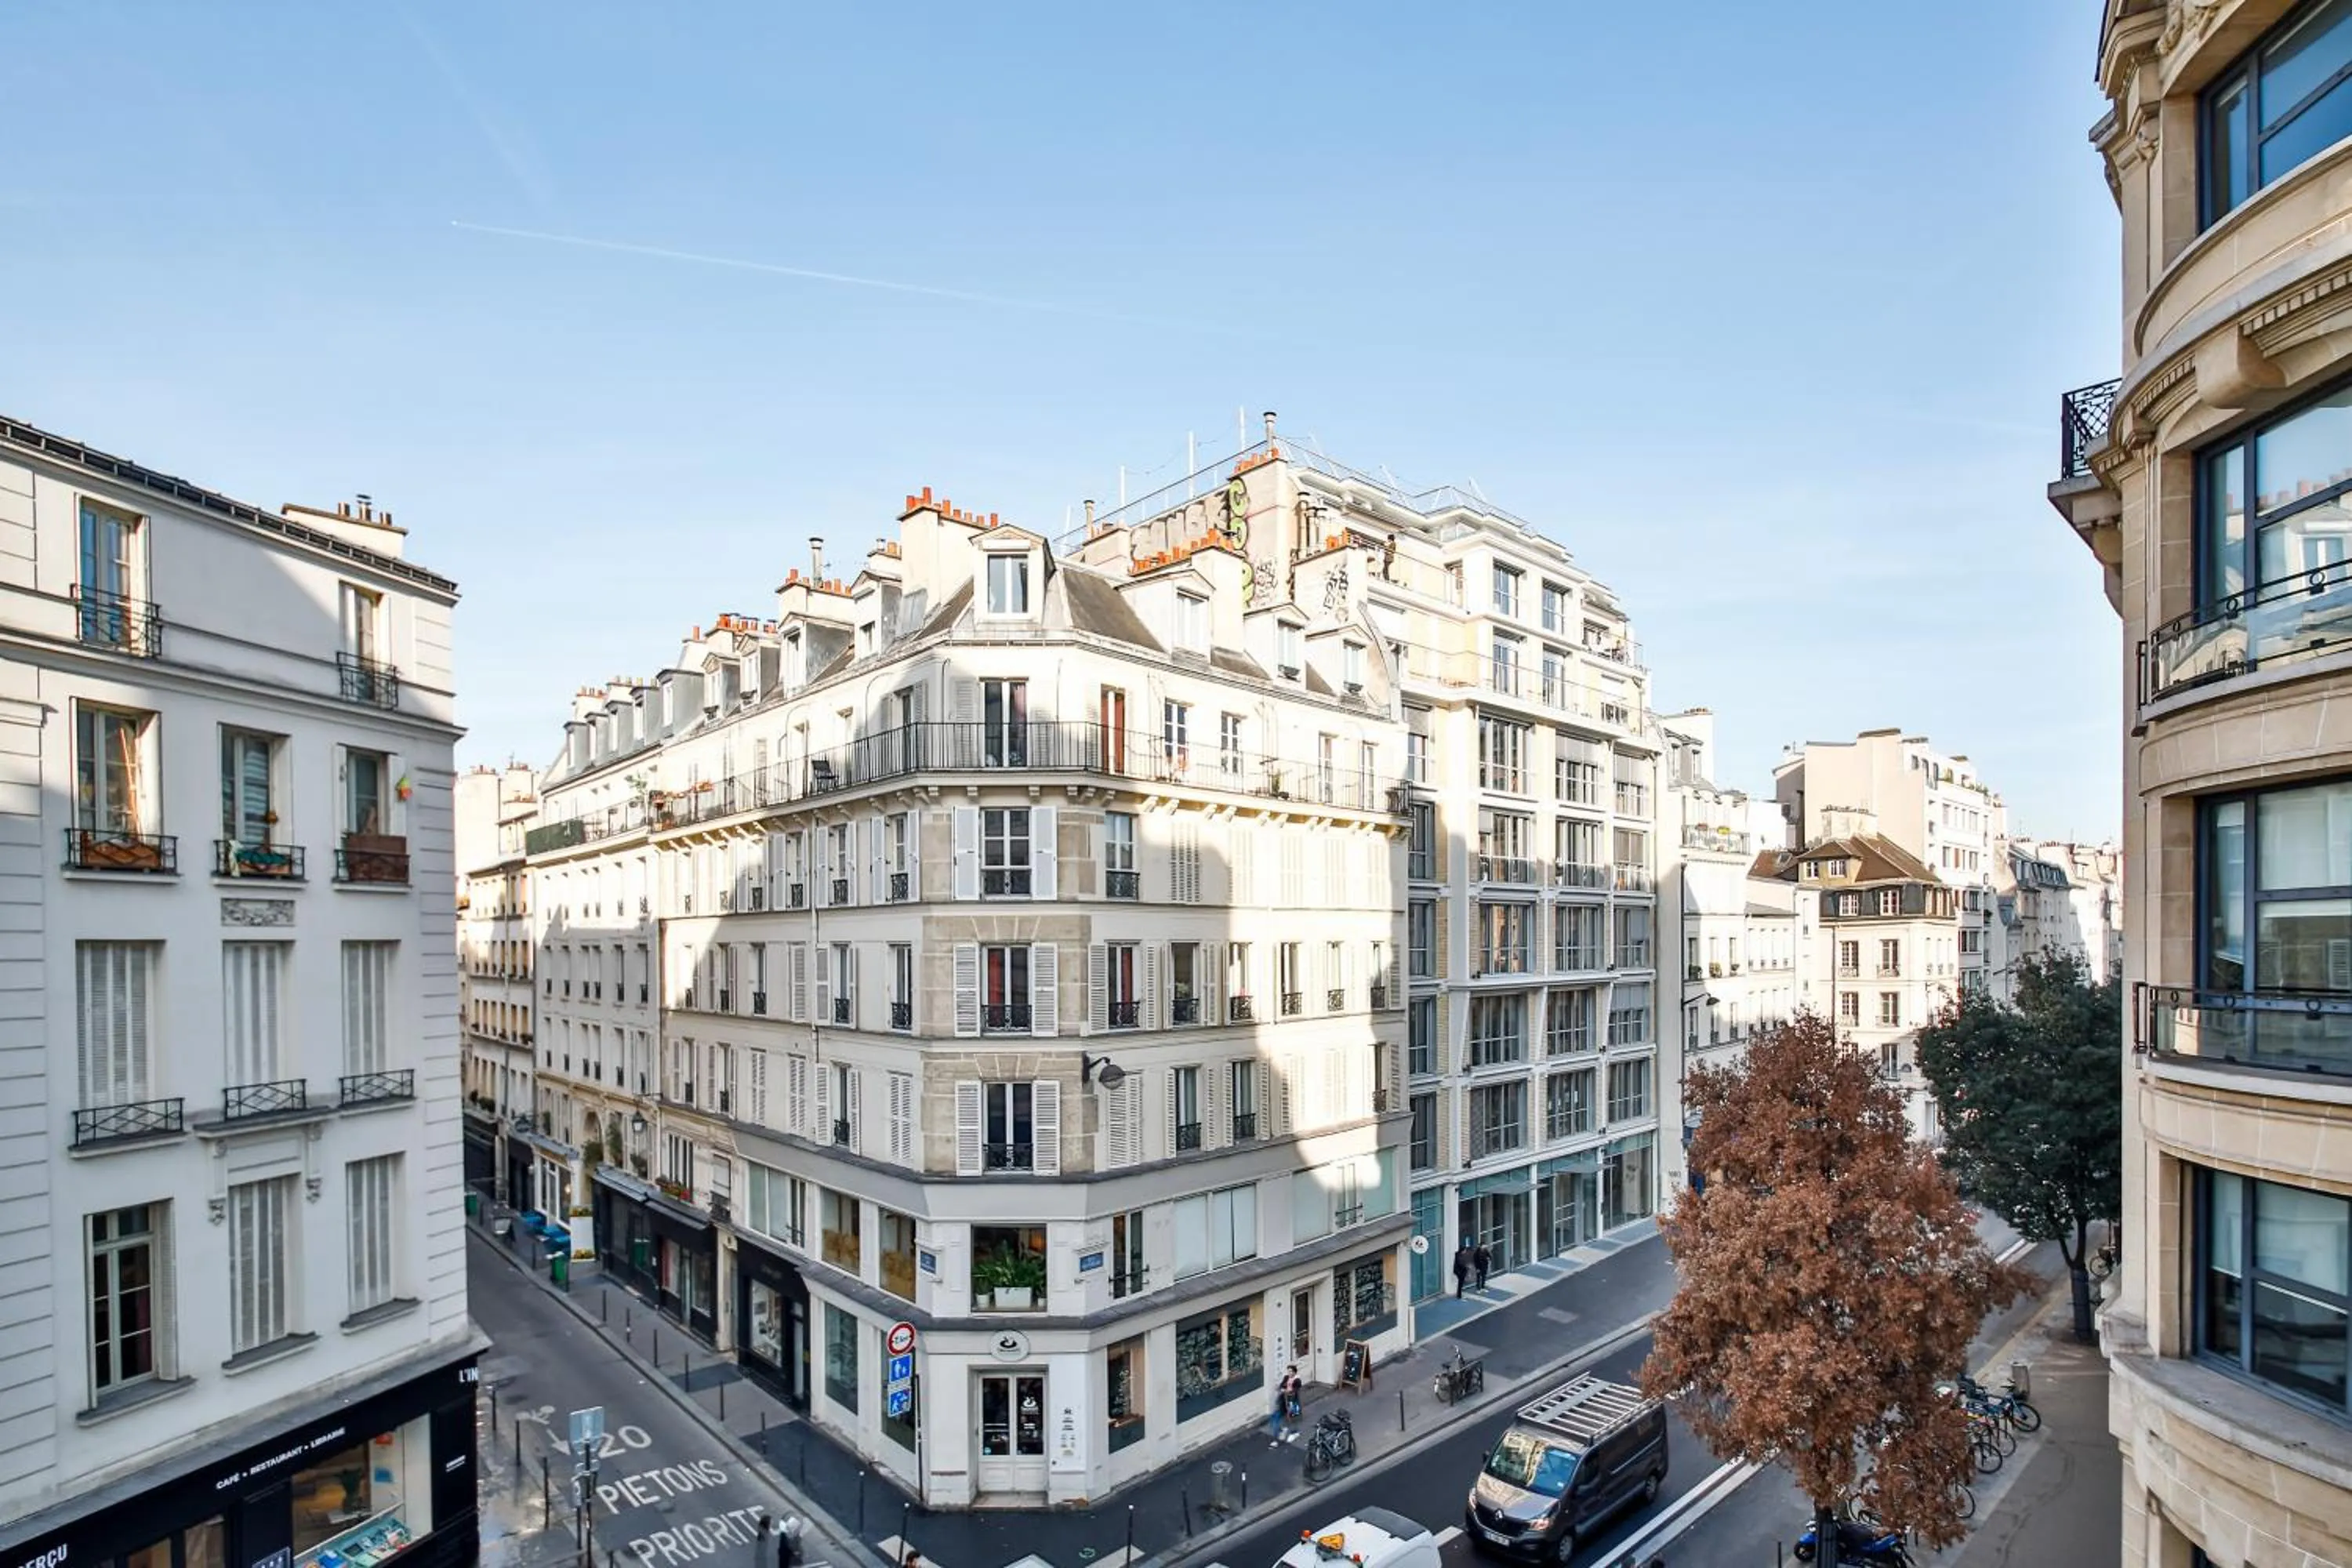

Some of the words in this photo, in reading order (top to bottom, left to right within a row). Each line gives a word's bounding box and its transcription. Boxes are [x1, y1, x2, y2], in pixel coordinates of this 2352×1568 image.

[597, 1425, 652, 1459] 20
[250, 1446, 303, 1475] RESTAURANT
[595, 1459, 728, 1515] PIETONS
